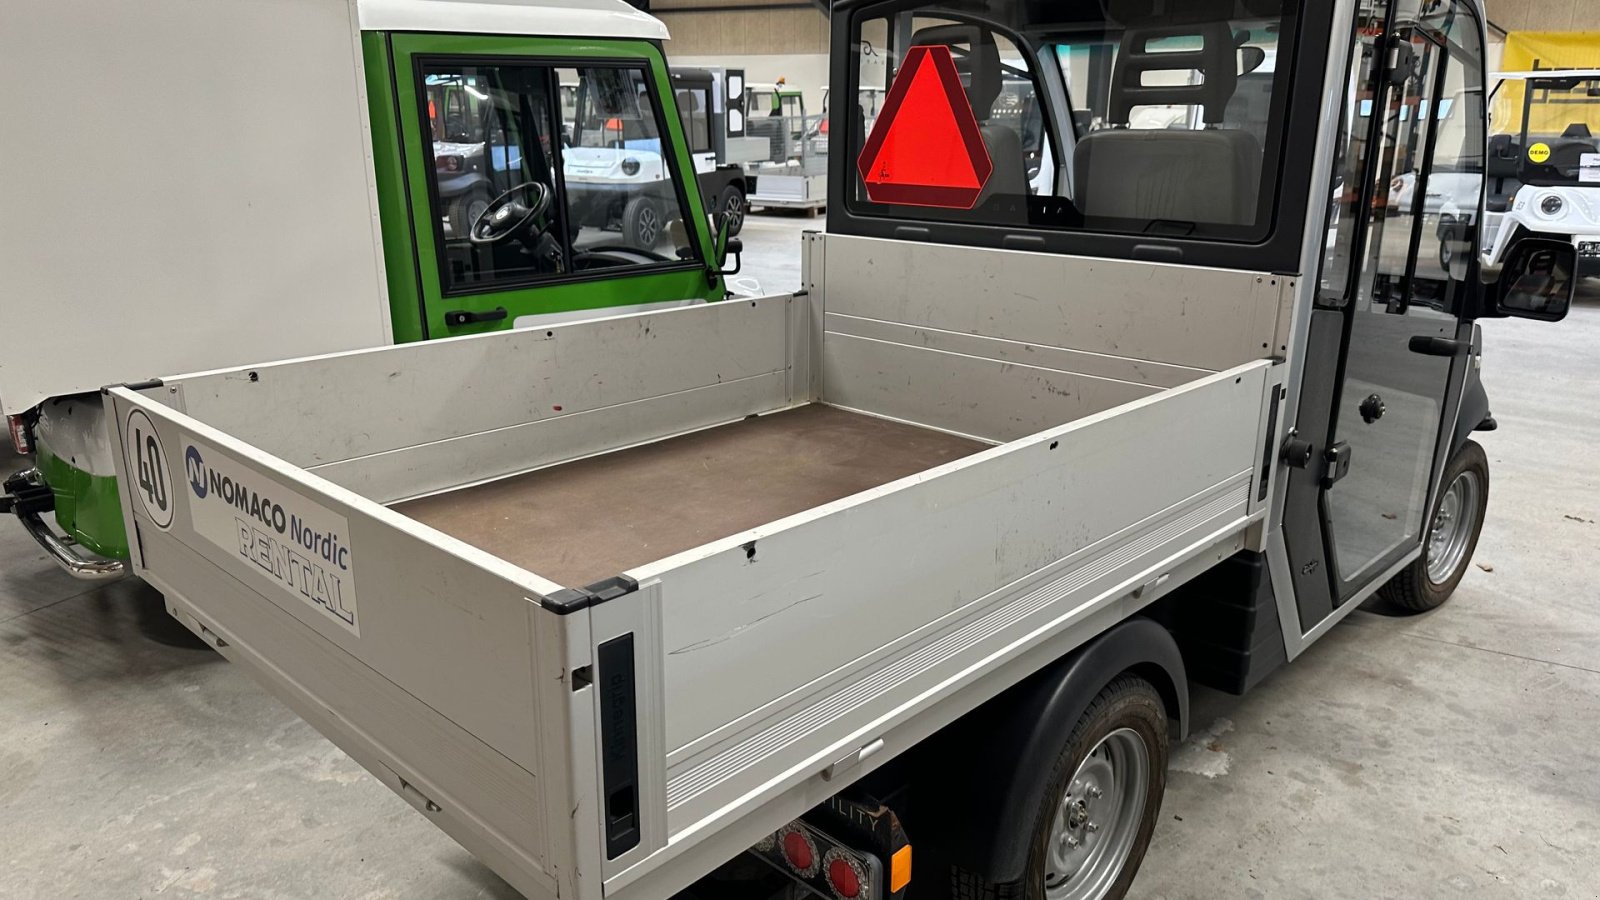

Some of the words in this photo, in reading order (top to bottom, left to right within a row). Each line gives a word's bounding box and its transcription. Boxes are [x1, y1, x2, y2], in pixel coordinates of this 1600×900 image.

[135, 428, 167, 512] 40
[209, 468, 287, 534] NOMACO
[290, 514, 348, 571] Nordic
[235, 516, 355, 626] RENTAL
[823, 795, 879, 832] ILITY
